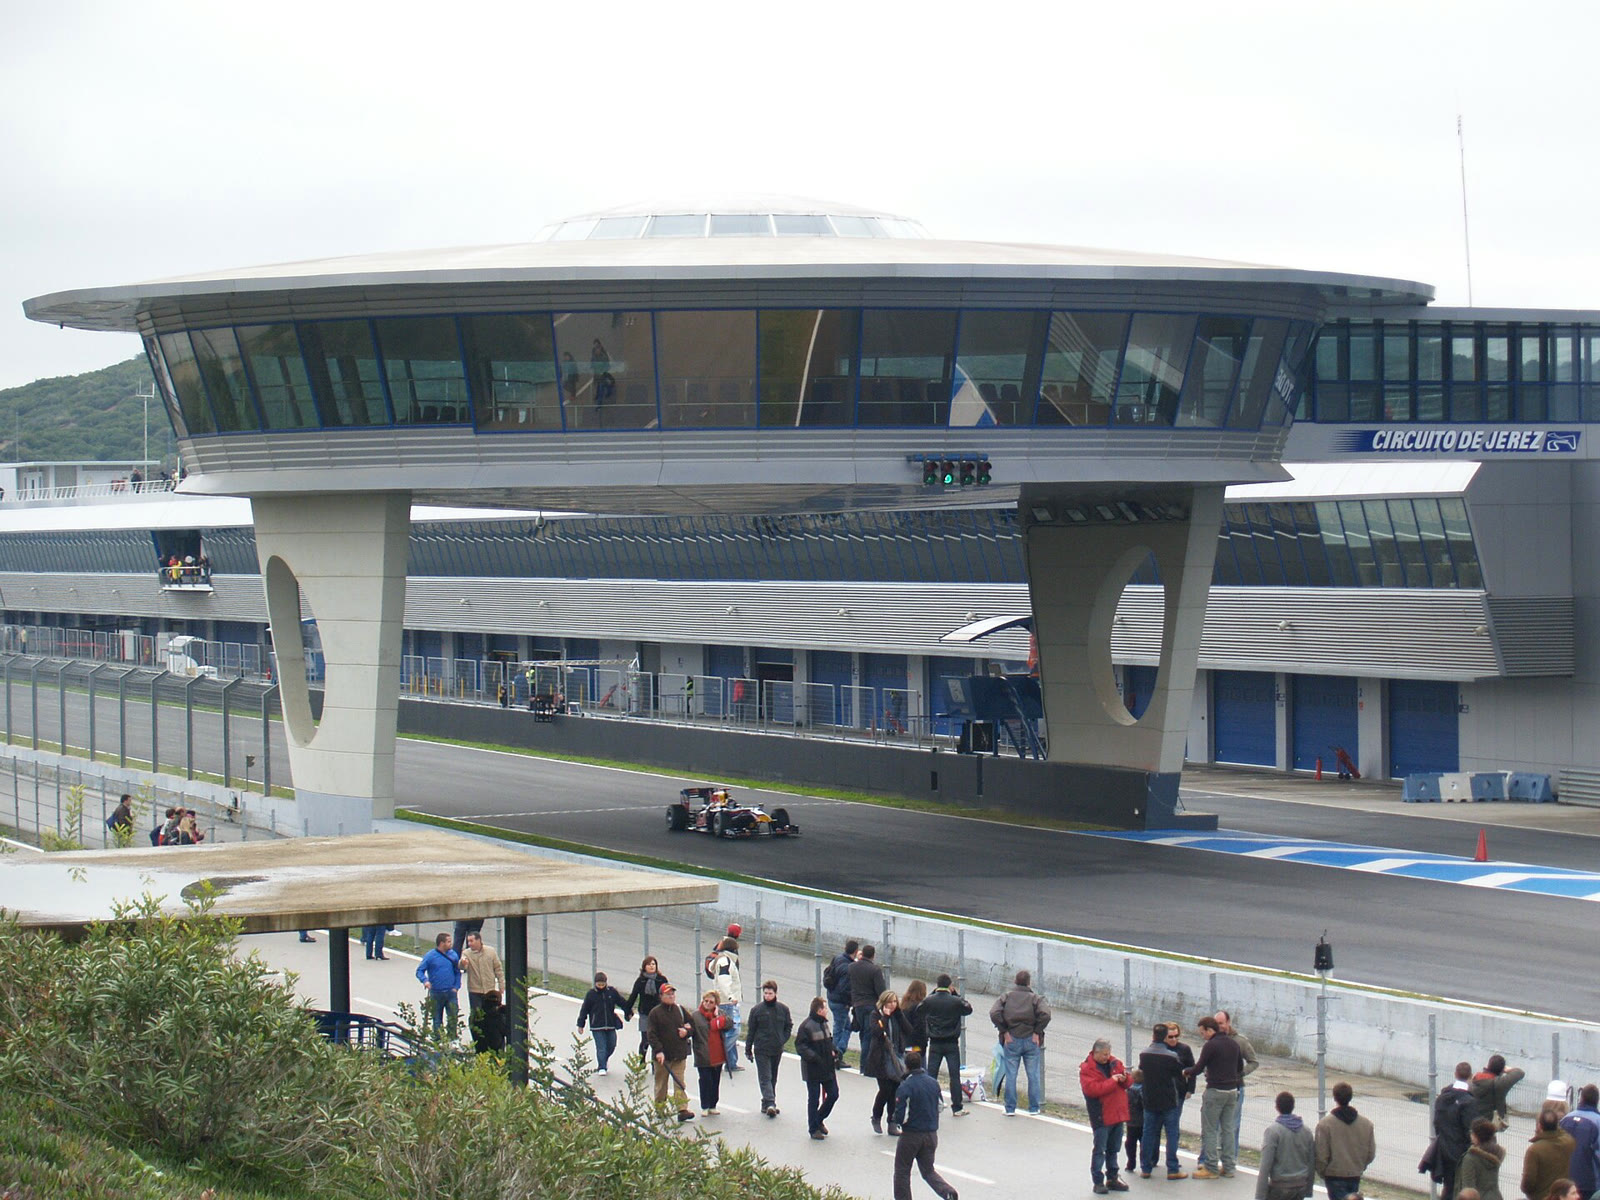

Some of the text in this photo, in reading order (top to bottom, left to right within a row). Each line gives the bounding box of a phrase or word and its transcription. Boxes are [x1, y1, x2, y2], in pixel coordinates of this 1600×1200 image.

[1372, 430, 1544, 450] CIRCUITO DE JEREZ
